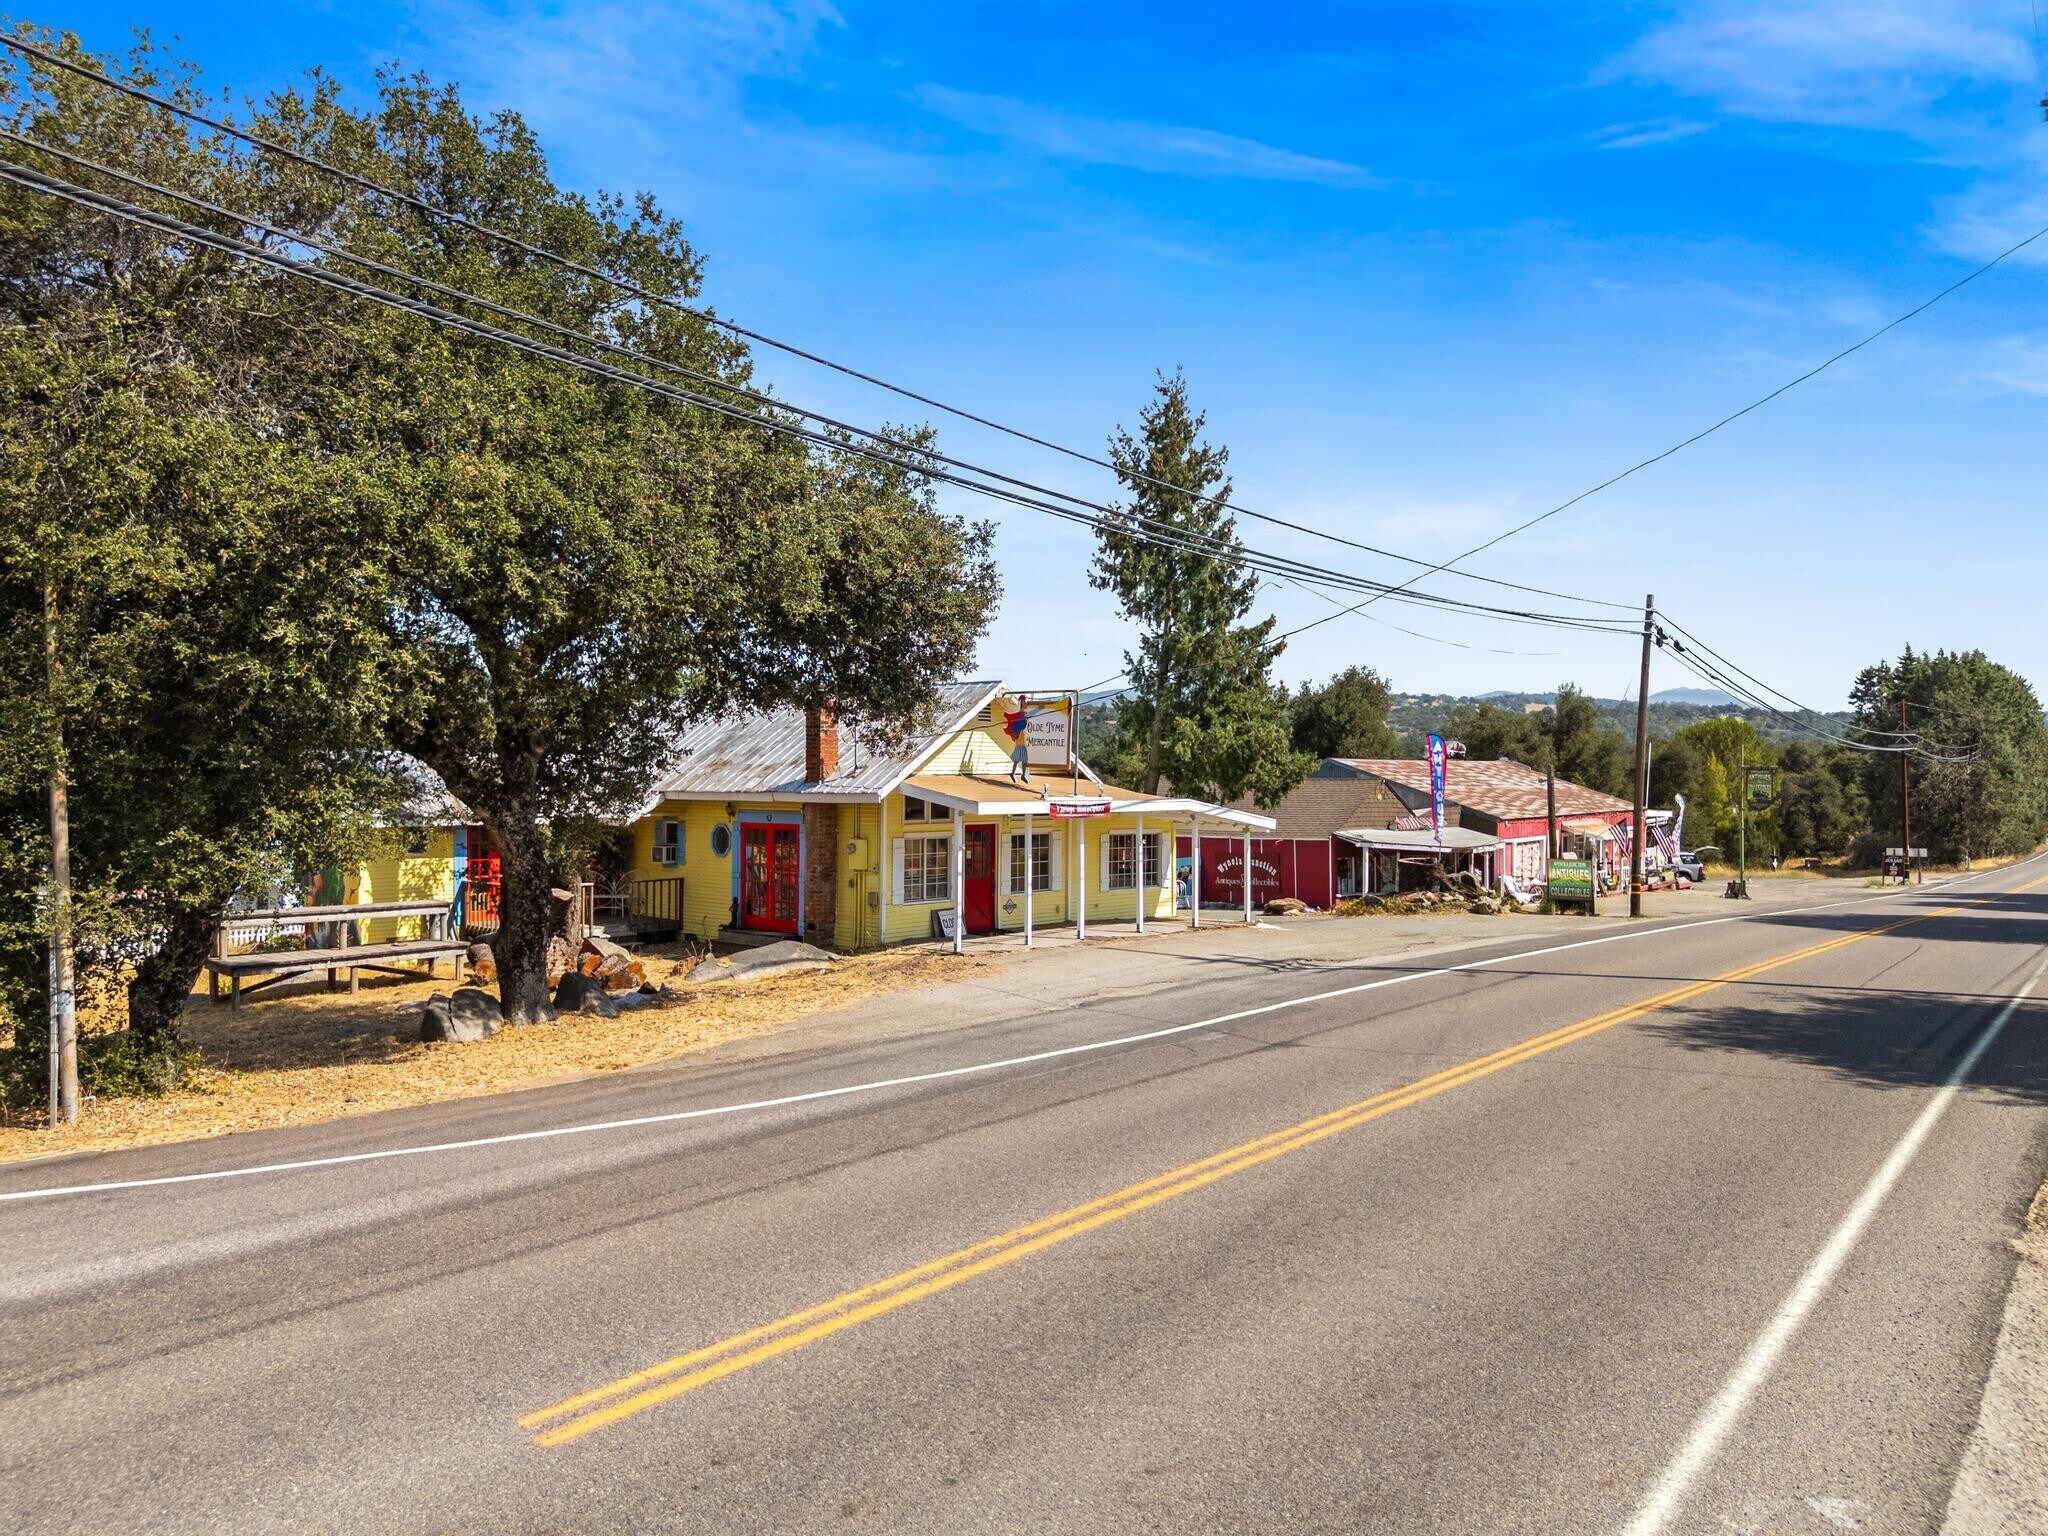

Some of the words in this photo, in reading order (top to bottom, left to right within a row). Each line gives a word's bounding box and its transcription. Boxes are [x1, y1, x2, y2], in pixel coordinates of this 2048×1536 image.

[1027, 721, 1043, 733] OLDE
[1045, 722, 1065, 733] TYME
[1026, 737, 1065, 747] MERCANTILE
[1217, 856, 1243, 873] Wynola
[1552, 868, 1589, 880] ANTIQUES
[1215, 877, 1240, 886] Antiques
[1550, 886, 1590, 897] COLLECTIBLES
